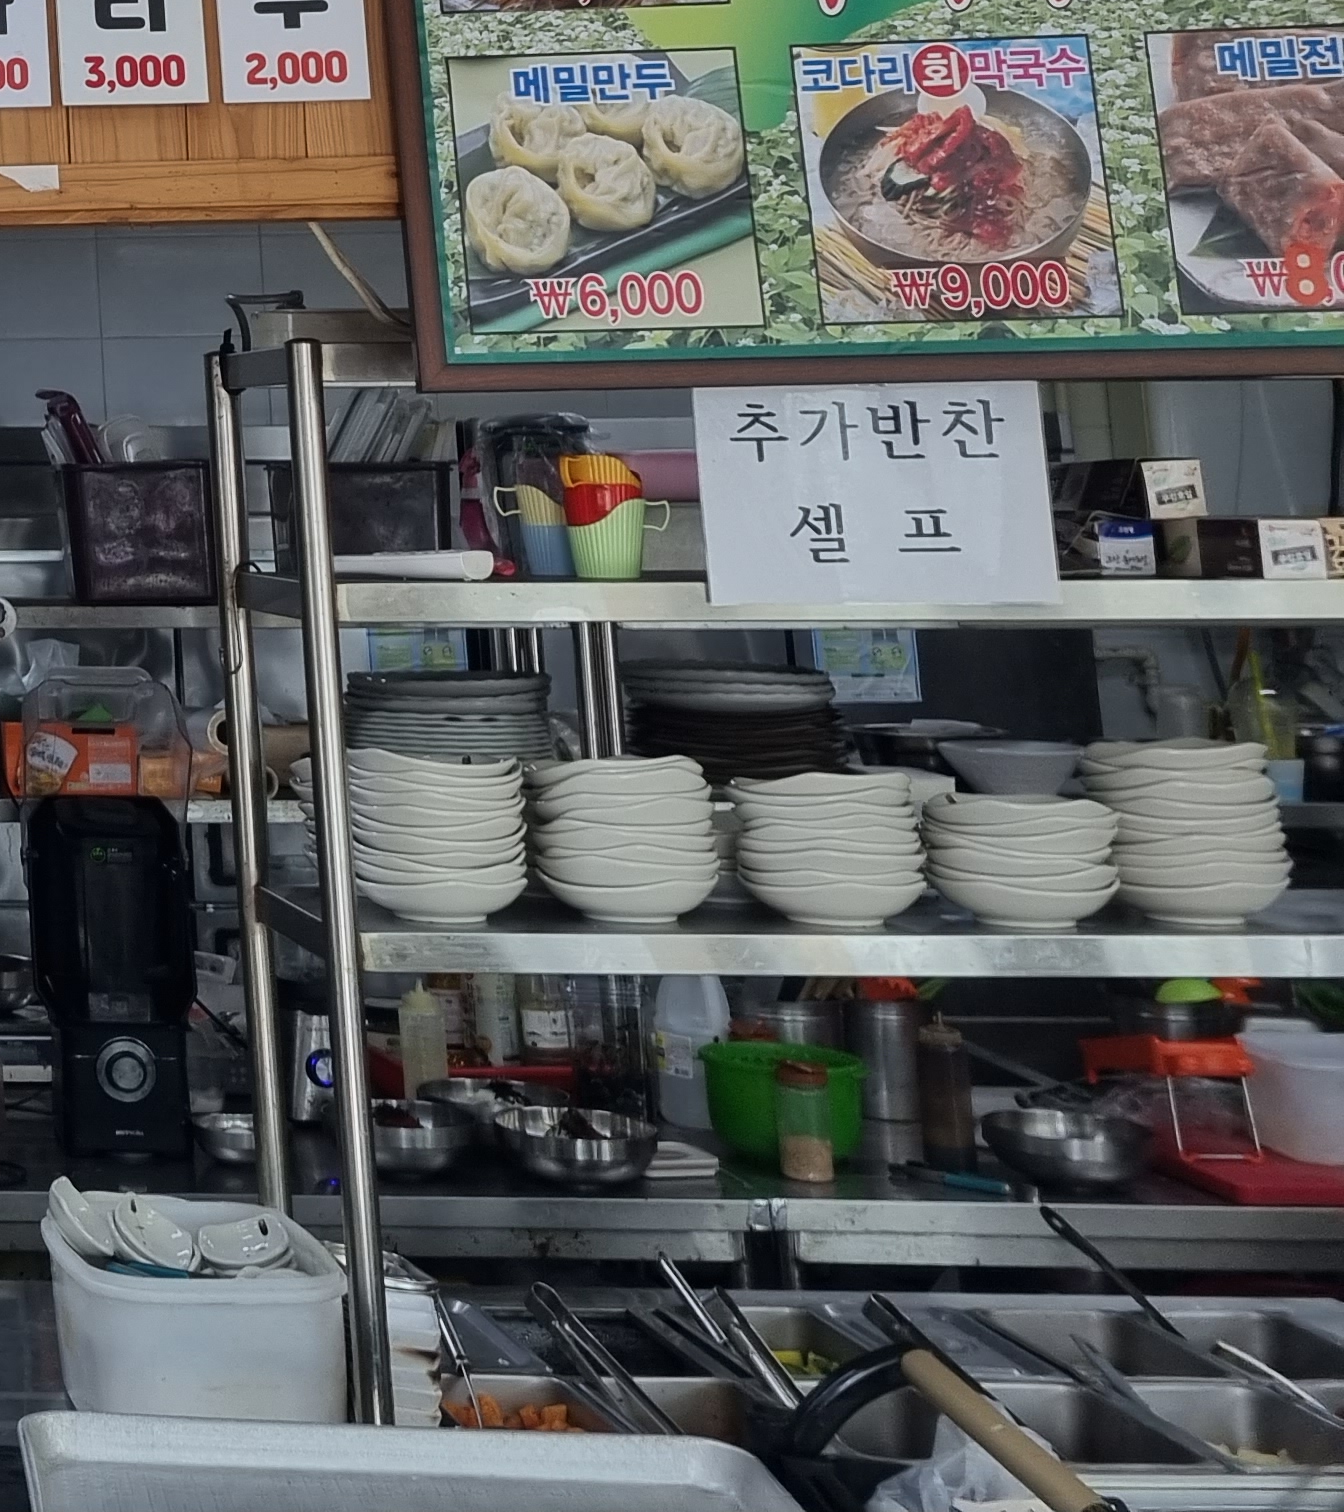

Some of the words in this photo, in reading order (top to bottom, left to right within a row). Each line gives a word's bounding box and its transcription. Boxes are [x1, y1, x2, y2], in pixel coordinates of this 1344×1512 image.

[85, 53, 187, 92] 3,000
[246, 50, 349, 89] 2,000
[1214, 35, 1344, 82] 메밀전
[511, 60, 675, 105] 메밀만두
[527, 270, 704, 325] ₩6,000
[889, 260, 1070, 317] ₩9,000
[728, 398, 1006, 464] 추가반찬
